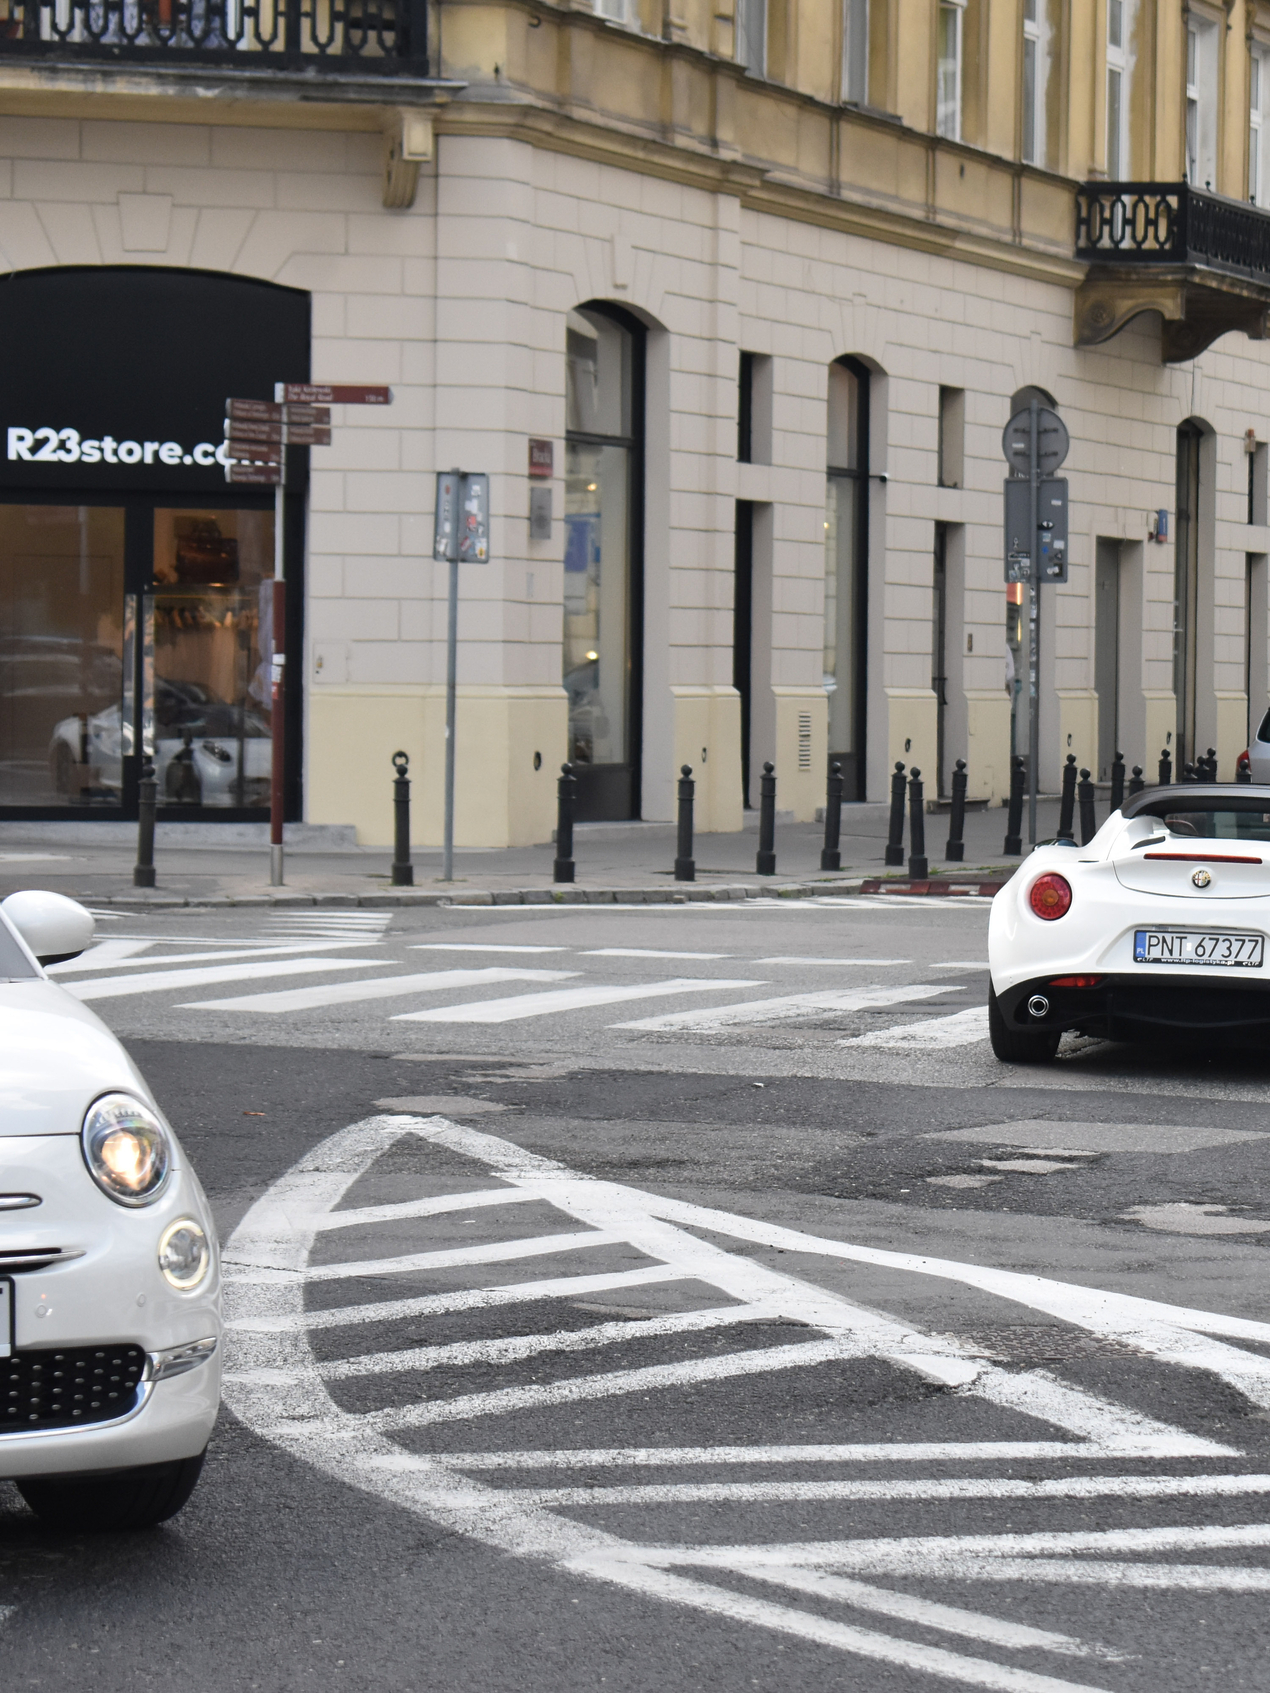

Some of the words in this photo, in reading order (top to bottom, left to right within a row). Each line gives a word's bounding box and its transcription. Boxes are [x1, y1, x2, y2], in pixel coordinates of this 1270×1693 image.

[8, 427, 278, 466] R23store.co
[1148, 935, 1187, 957] PNT
[1195, 937, 1259, 960] 67377
